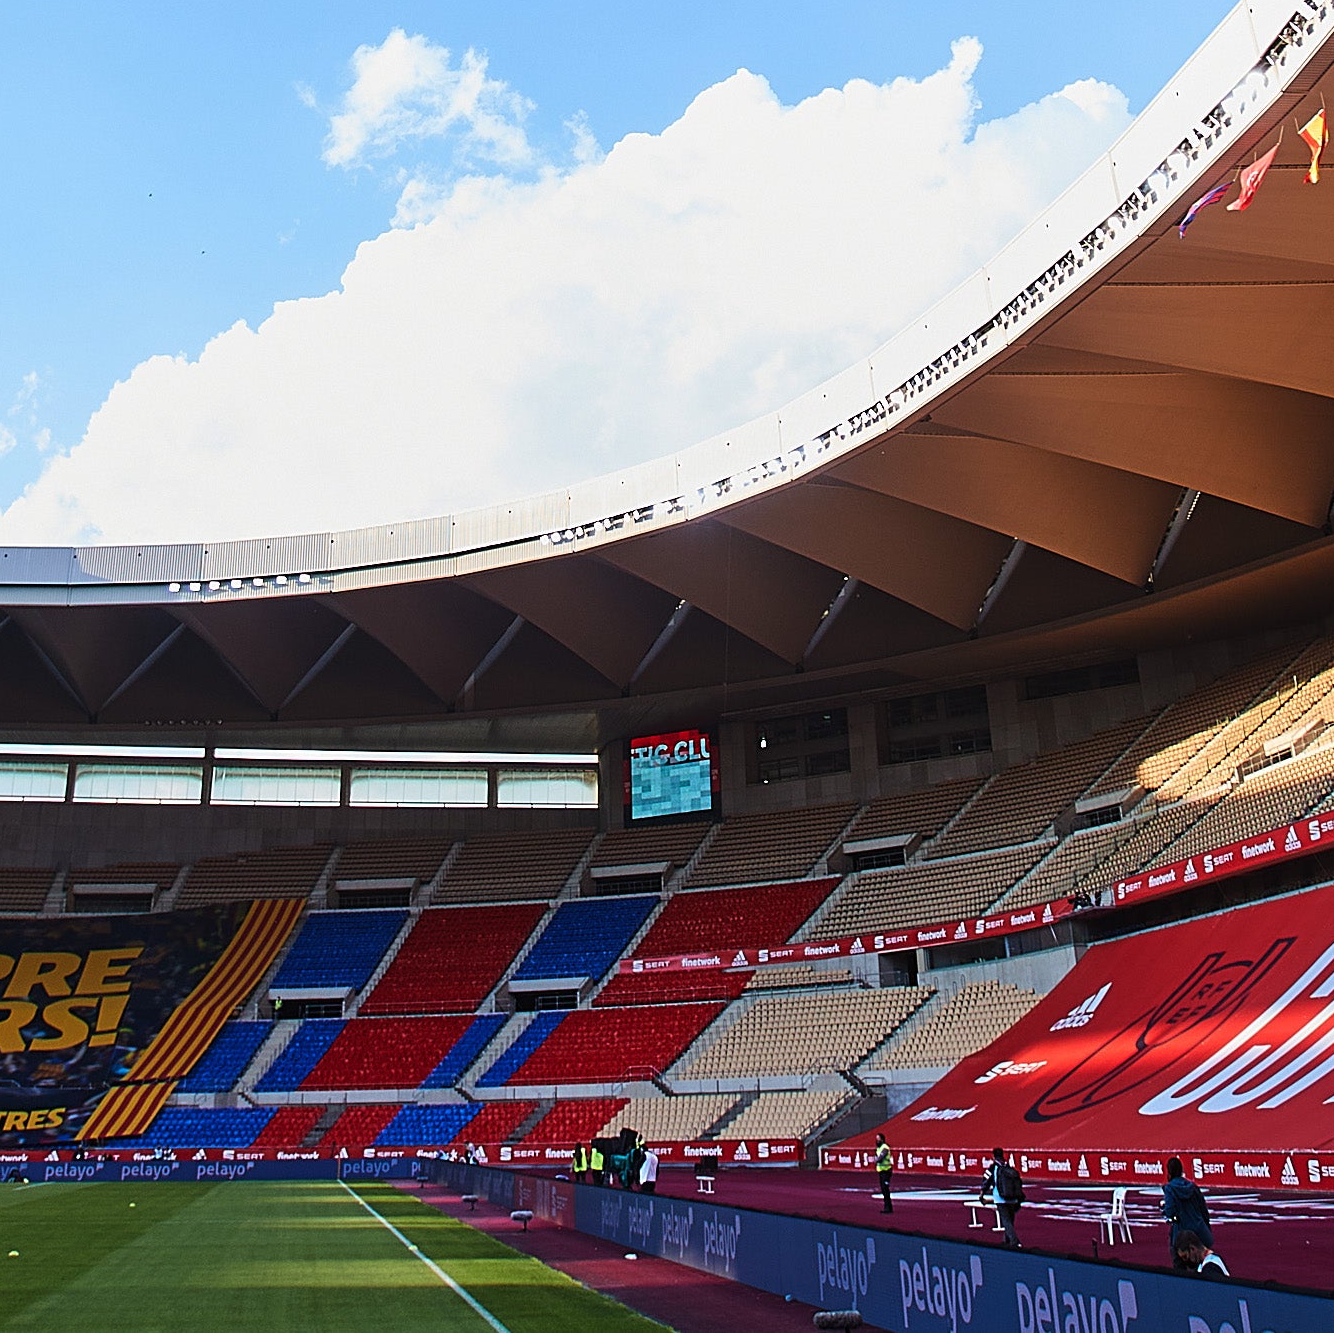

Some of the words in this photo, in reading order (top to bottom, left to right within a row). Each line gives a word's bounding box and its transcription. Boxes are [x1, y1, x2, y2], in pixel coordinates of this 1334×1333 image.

[1241, 838, 1276, 860] finetwork
[1213, 851, 1234, 866] SEAT
[1125, 880, 1142, 894] SEAT
[985, 919, 1005, 930] SEAT
[885, 934, 909, 944] SEAT
[917, 927, 947, 942] finetwork
[770, 949, 794, 958] SEAT
[804, 943, 840, 956] finetwork
[681, 955, 721, 968] finetwork
[236, 1152, 265, 1160] SEAT
[377, 1150, 405, 1158] SEAT
[513, 1149, 541, 1157] SEAT
[684, 1145, 723, 1157] finetwork
[770, 1145, 796, 1154] SEAT
[44, 1163, 95, 1181] pelayo
[121, 1161, 171, 1181] pelayo
[196, 1161, 246, 1180] pelayo
[343, 1159, 391, 1178] pelayo
[1109, 1161, 1127, 1171] SEAT
[1134, 1160, 1163, 1175] finetwork
[1204, 1163, 1225, 1174] SEAT
[1234, 1161, 1270, 1178] finetwork
[1280, 1174, 1300, 1185] adidas
[662, 1203, 690, 1259] pelayo
[703, 1211, 737, 1273] pelayo
[818, 1231, 869, 1311] pelayo
[899, 1247, 974, 1333] pelayo
